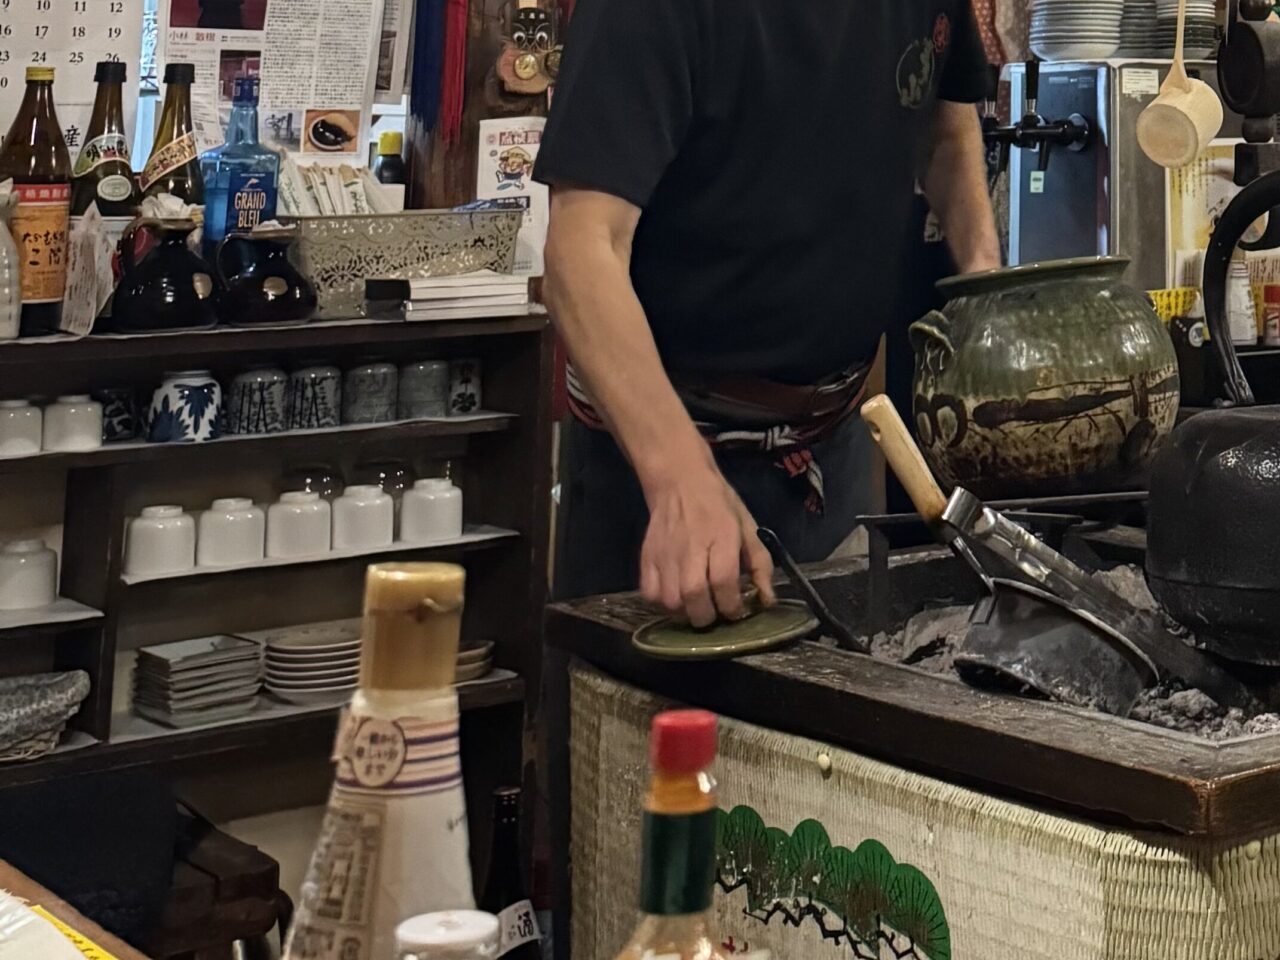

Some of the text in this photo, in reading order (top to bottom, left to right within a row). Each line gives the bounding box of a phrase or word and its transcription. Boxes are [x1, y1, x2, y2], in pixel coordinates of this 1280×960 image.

[37, 0, 51, 11] 10
[74, 1, 87, 12] 11
[110, 2, 123, 13] 12
[35, 26, 49, 37] 17
[72, 26, 86, 37] 18
[108, 27, 122, 38] 19
[0, 50, 120, 63] 3 24 25 26
[0, 77, 9, 88] 0
[234, 191, 266, 210] GRAND
[237, 210, 261, 229] BLEU
